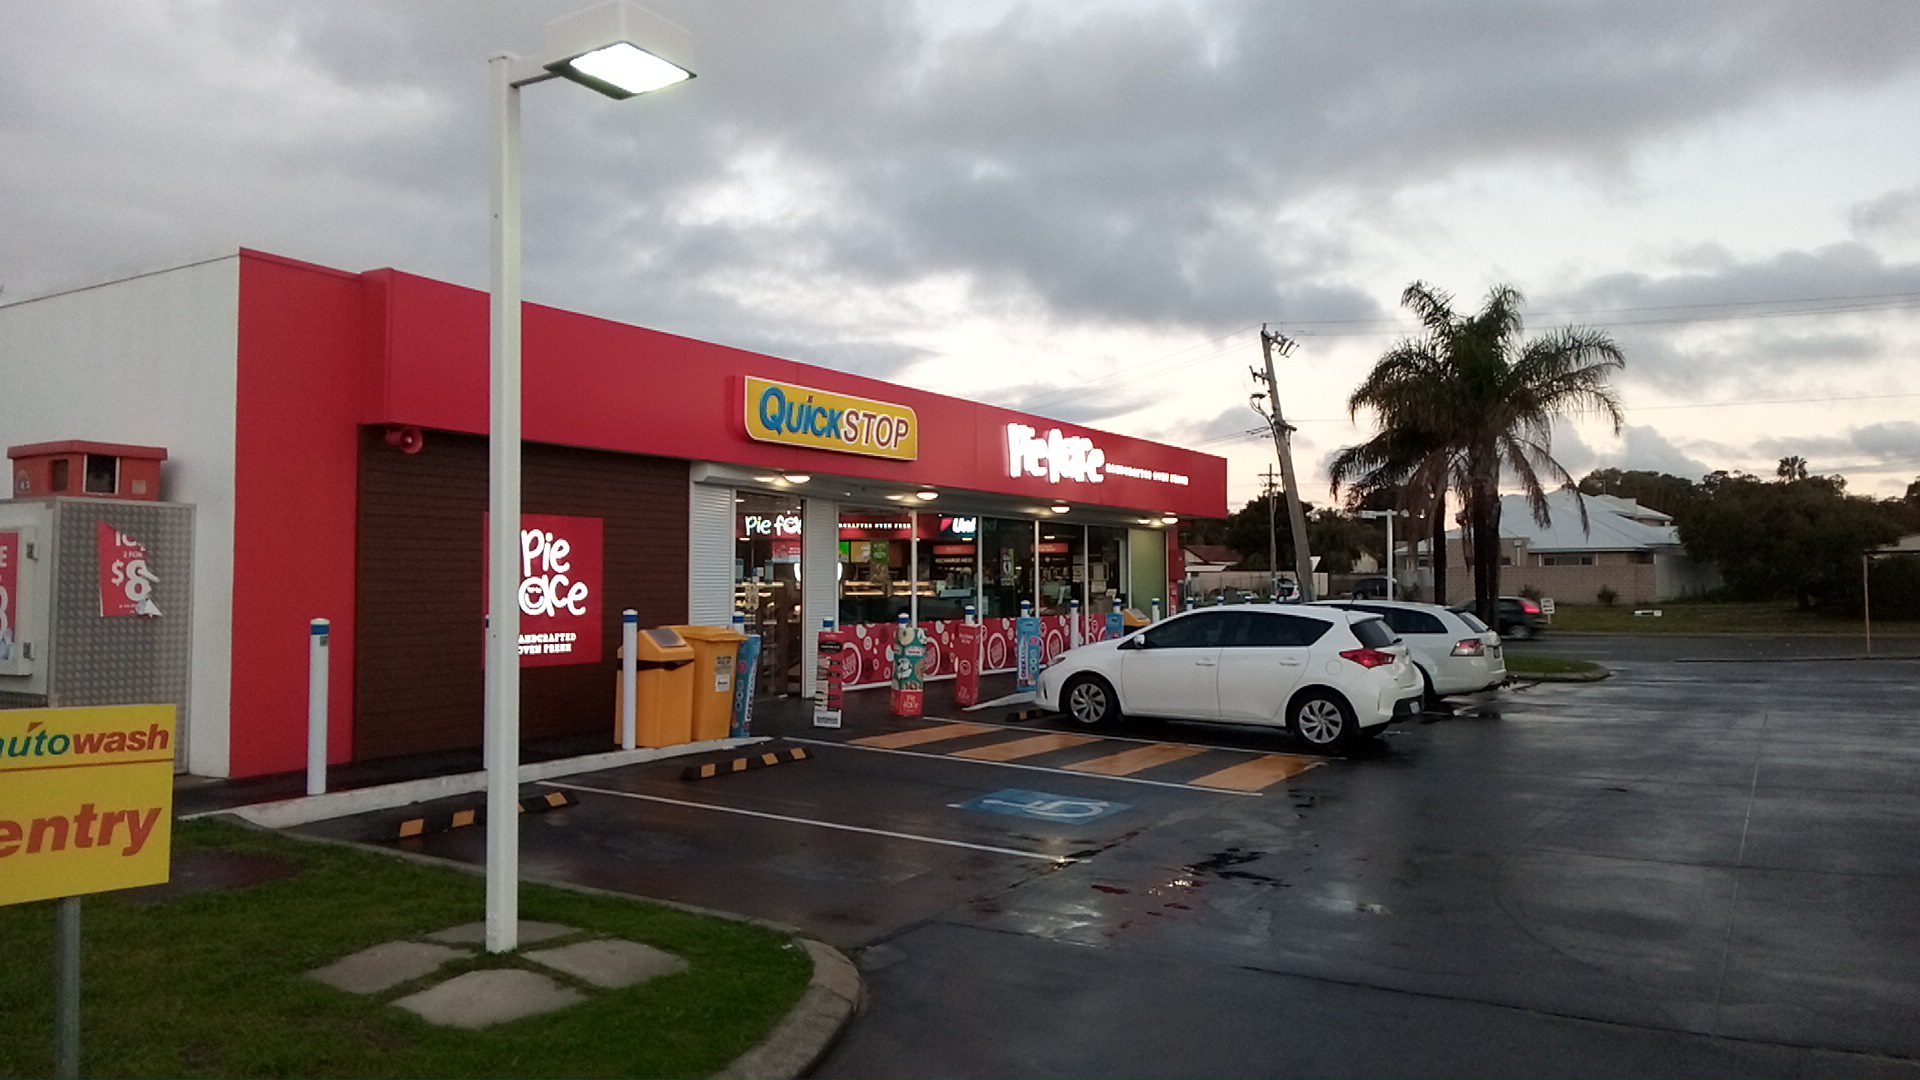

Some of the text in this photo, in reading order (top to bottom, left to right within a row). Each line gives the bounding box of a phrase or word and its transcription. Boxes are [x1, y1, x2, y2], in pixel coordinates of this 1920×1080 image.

[521, 529, 571, 577] Pie
[518, 574, 589, 618] ace
[518, 632, 577, 645] ANDCRAFTED
[0, 803, 162, 858] entry
